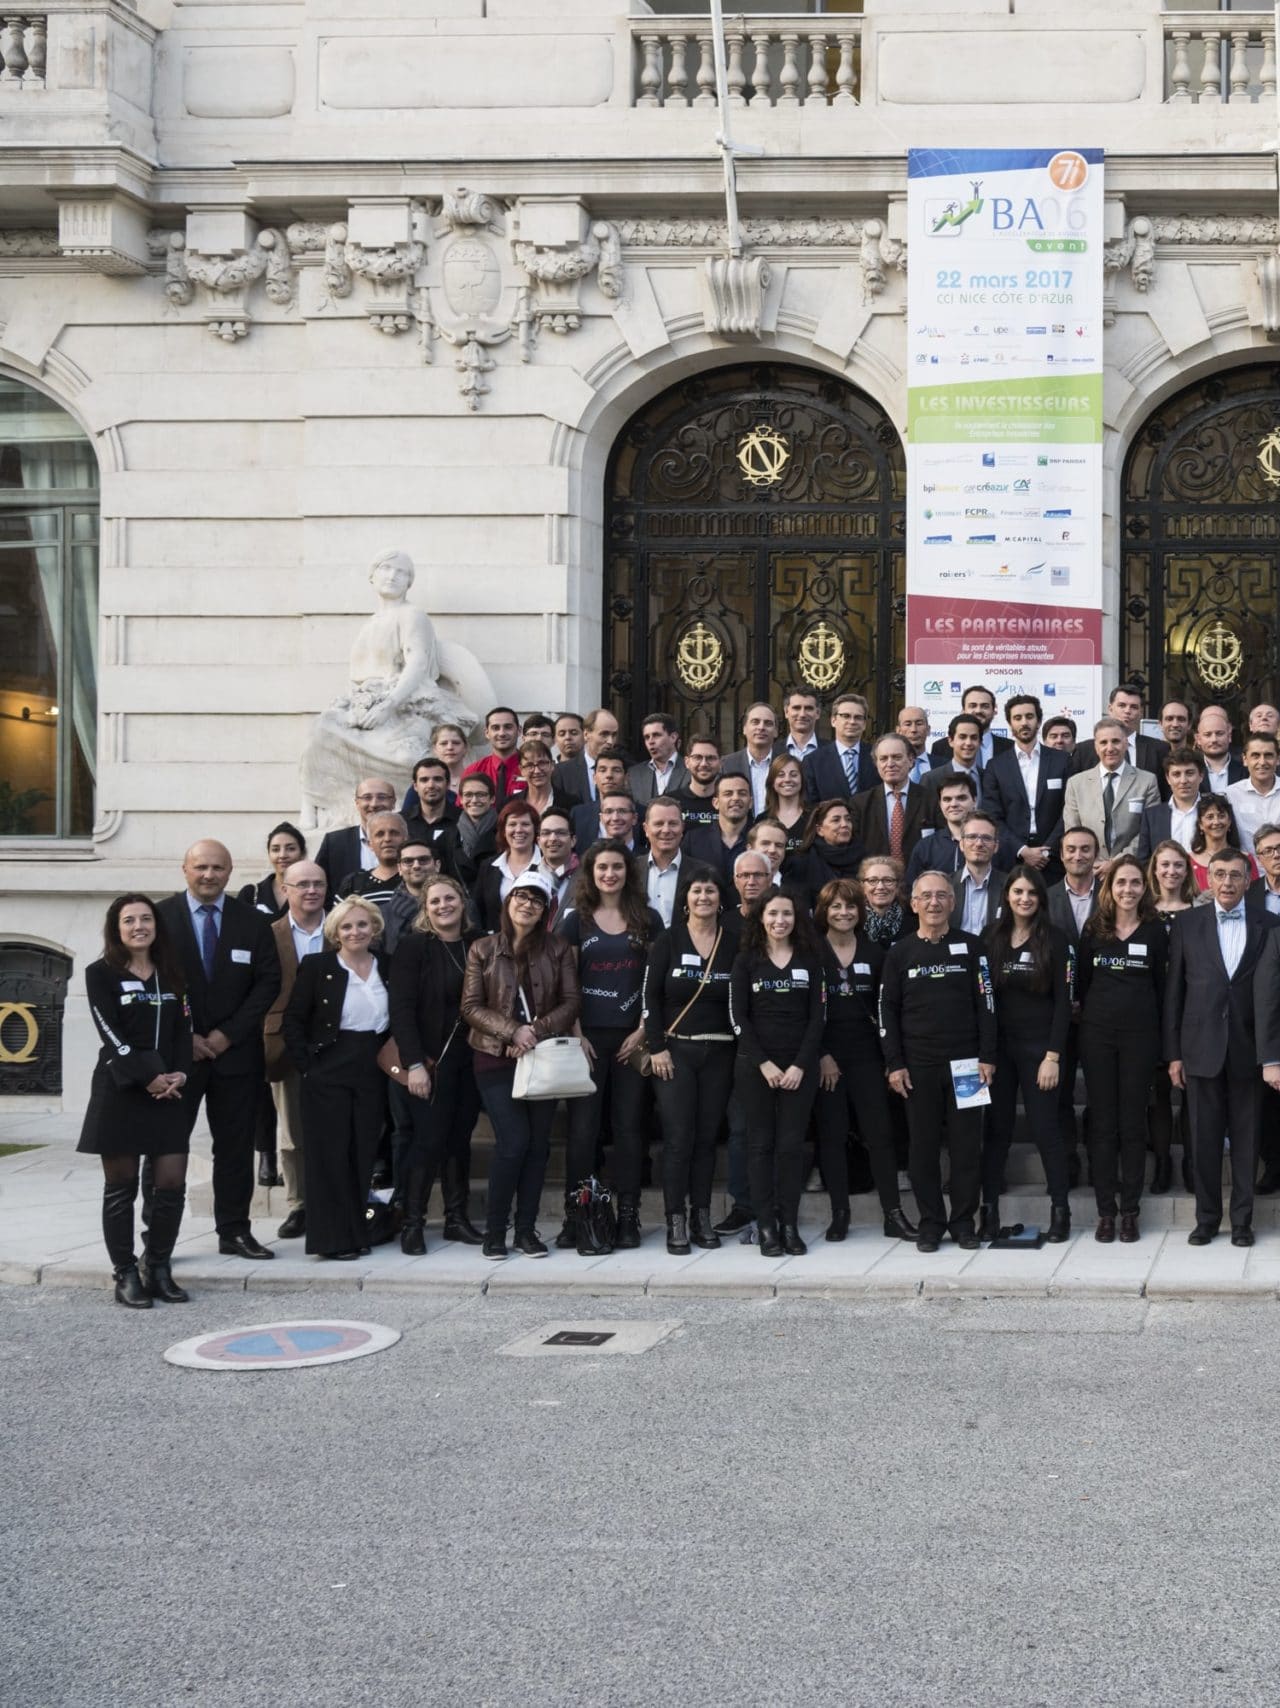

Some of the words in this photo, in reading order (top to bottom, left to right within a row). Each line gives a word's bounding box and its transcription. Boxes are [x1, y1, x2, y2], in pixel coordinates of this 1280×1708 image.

[990, 197, 1088, 231] BA06
[936, 270, 962, 289] 22
[969, 275, 1018, 289] mars
[1025, 270, 1073, 289] 2017
[936, 292, 954, 305] CCI
[959, 292, 986, 305] NICE
[992, 290, 1023, 305] CÔTE
[1029, 292, 1073, 305] D'AZUR
[919, 395, 949, 412] LES
[955, 395, 1090, 412] INVESTISSEURS
[924, 618, 954, 634] LES
[961, 618, 1084, 634] PARTENAIRES
[983, 652, 1019, 661] Entreprises
[985, 668, 1023, 676] SPONSORS
